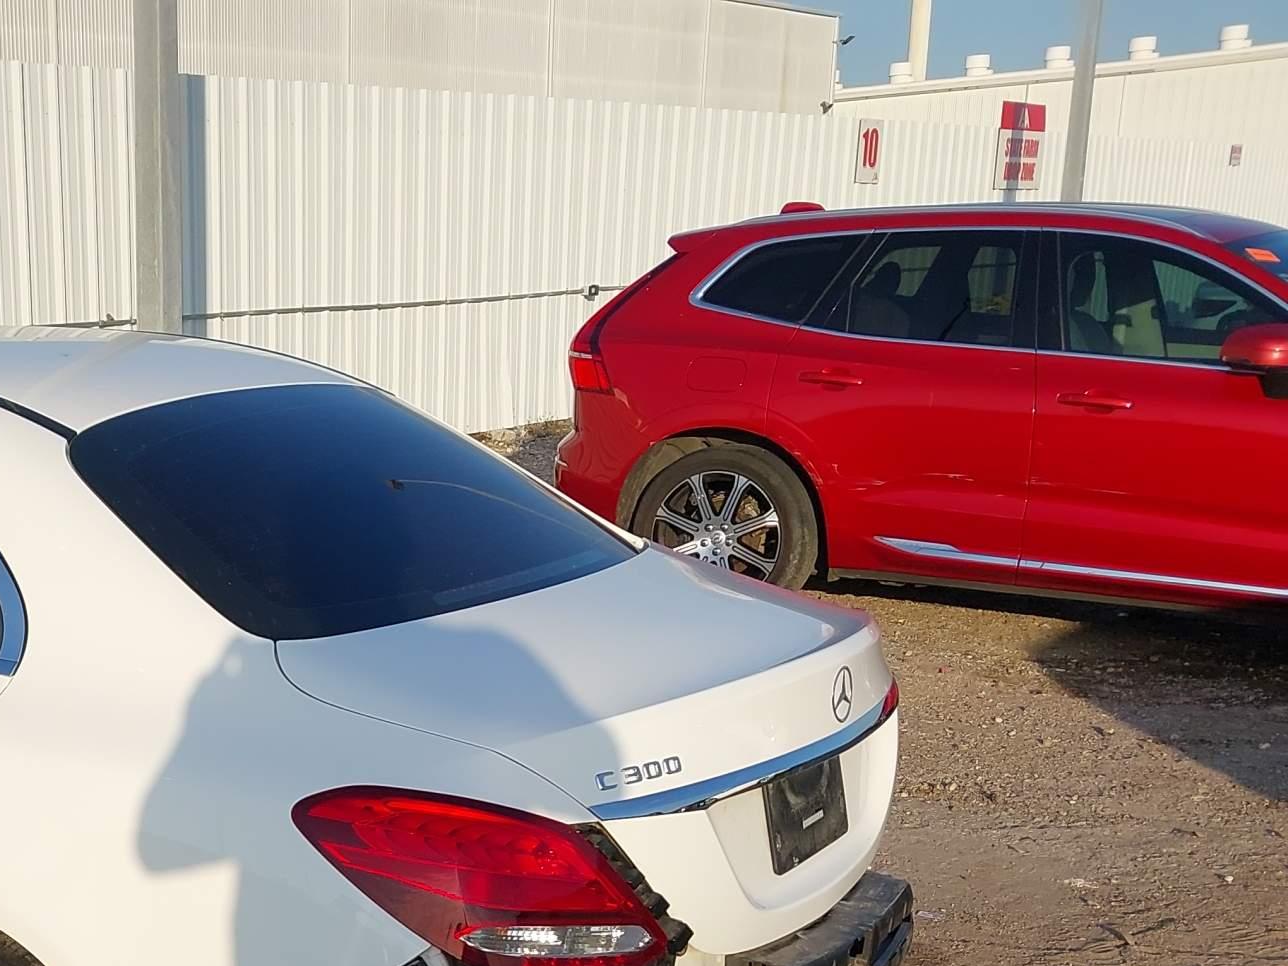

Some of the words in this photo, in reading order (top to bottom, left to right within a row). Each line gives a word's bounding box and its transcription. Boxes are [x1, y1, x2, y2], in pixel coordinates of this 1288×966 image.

[862, 127, 879, 168] 10
[594, 770, 618, 791] C
[620, 755, 682, 785] 300
